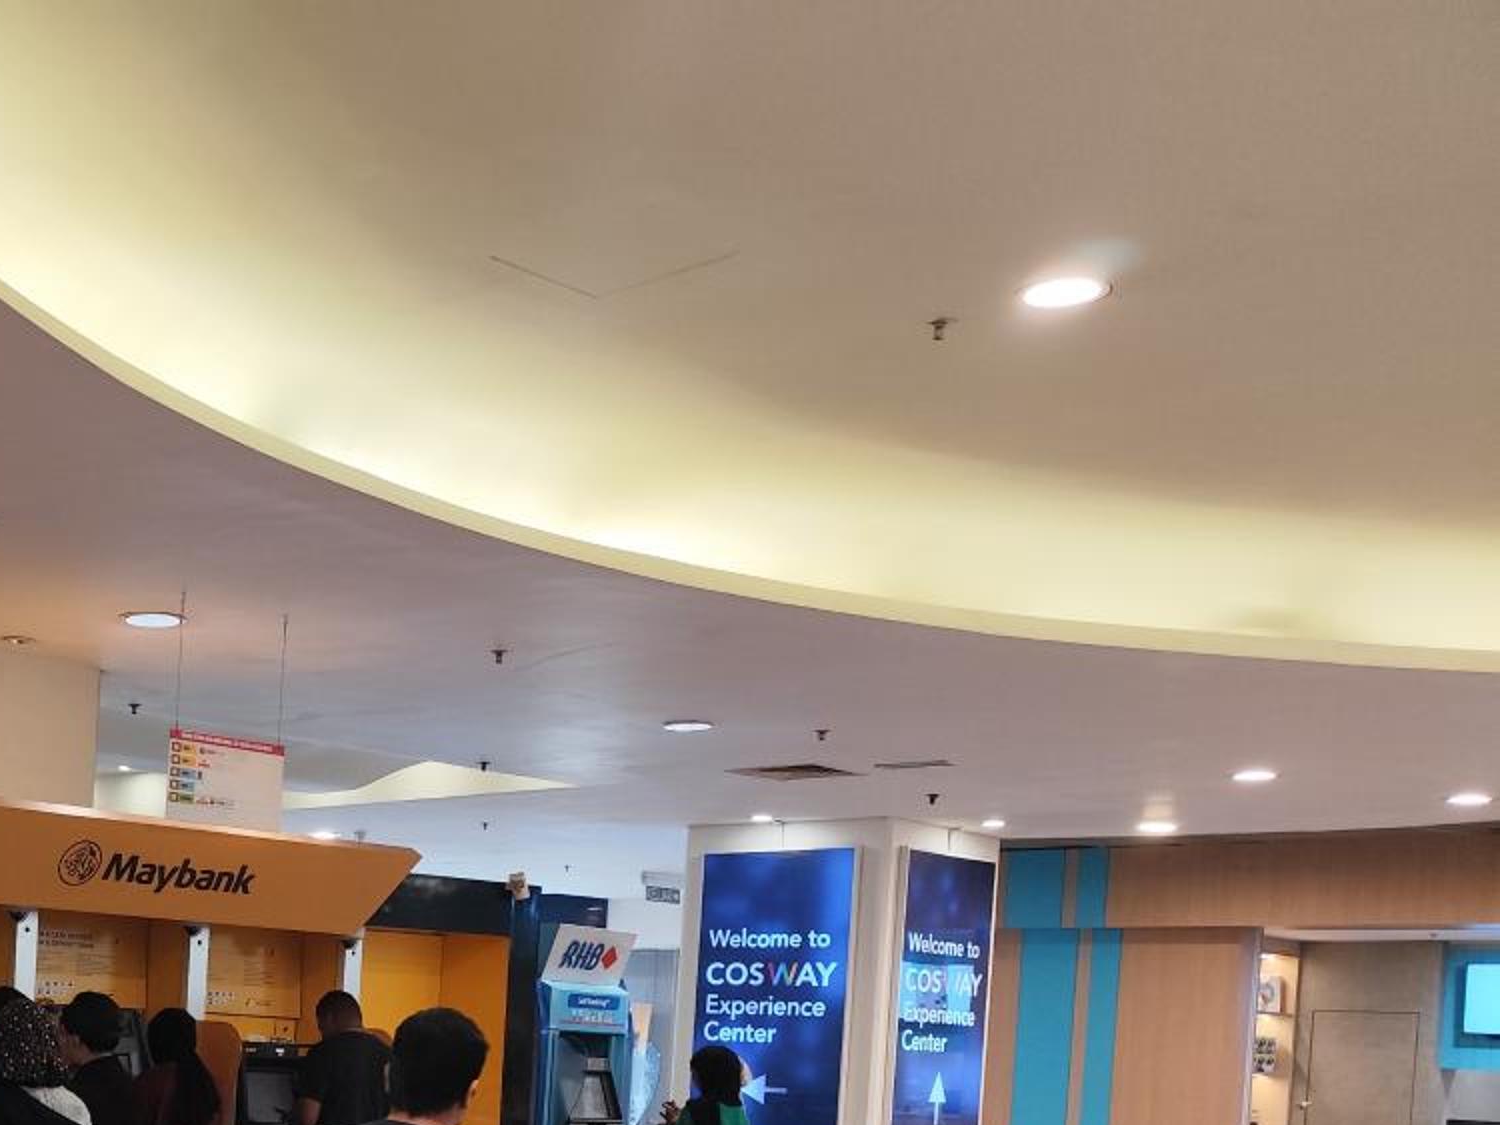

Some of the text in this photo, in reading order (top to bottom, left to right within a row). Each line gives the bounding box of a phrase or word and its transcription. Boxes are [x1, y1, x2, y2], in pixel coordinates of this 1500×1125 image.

[102, 853, 257, 894] Maybank
[709, 928, 831, 948] Welcome to
[908, 931, 980, 959] Welcome to
[558, 939, 605, 971] RHB
[706, 961, 837, 987] COSWAY
[705, 993, 826, 1020] Experience
[903, 1004, 975, 1028] Experience
[703, 1021, 777, 1042] Center
[901, 1029, 948, 1053] Center
